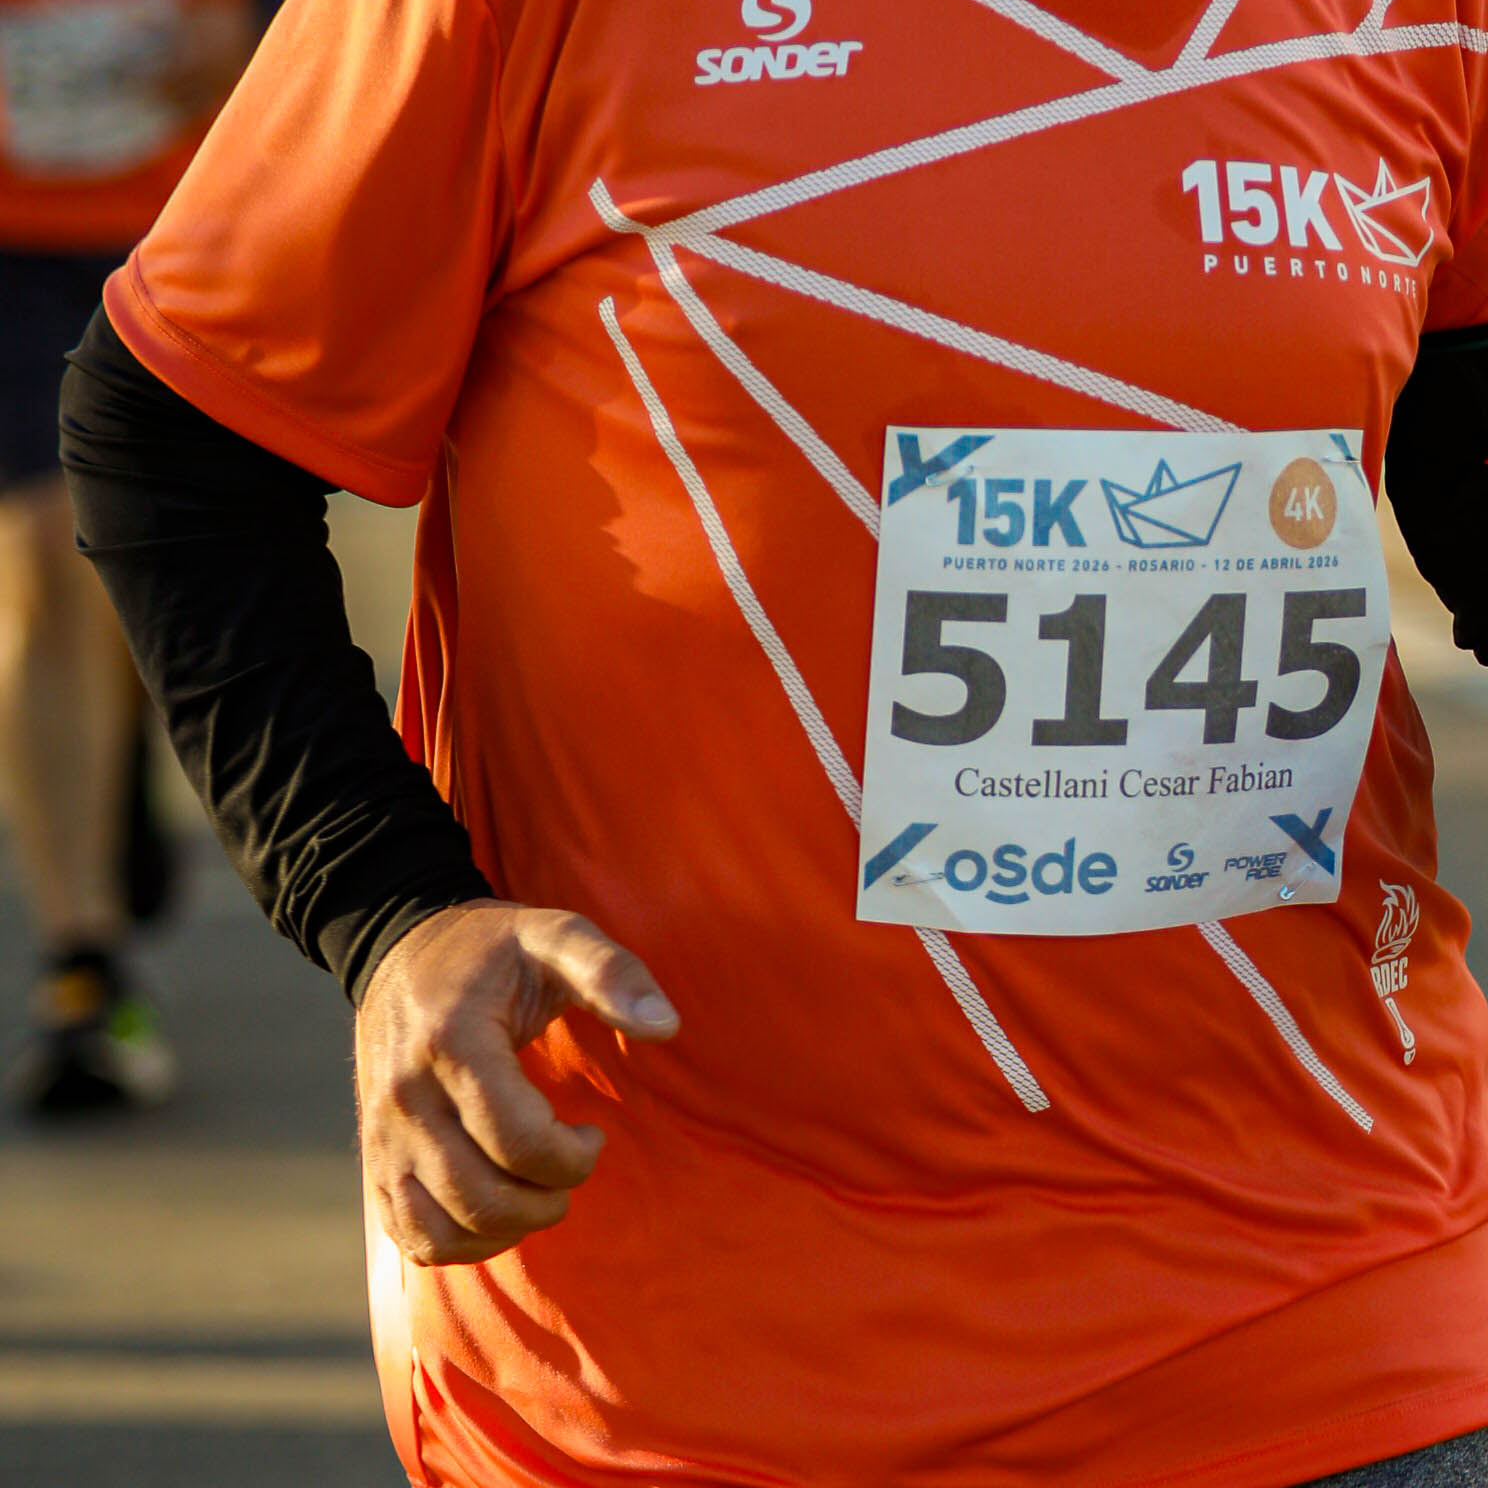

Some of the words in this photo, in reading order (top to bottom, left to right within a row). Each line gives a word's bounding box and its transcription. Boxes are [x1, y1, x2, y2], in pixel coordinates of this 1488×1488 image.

[1182, 160, 1343, 251] 15K
[1203, 254, 1348, 281] PUERTO
[1361, 265, 1416, 300] NORTE
[947, 478, 1088, 548] 15K
[1284, 486, 1324, 522] 4K
[943, 556, 1007, 570] PUERTO
[1014, 558, 1065, 572] NORTE
[1072, 559, 1109, 572] 2026
[1128, 559, 1195, 572] ROSARIO
[1214, 559, 1230, 571] 12
[1236, 558, 1254, 571] DE
[1260, 556, 1302, 570] ABRIL
[1308, 555, 1339, 568] 2026
[890, 587, 1367, 747] 5145
[954, 767, 1108, 799] Castellani
[1119, 769, 1200, 798] Cesar
[1207, 762, 1293, 795] Fabian
[944, 837, 1118, 896] osde
[1224, 852, 1288, 872] POWER
